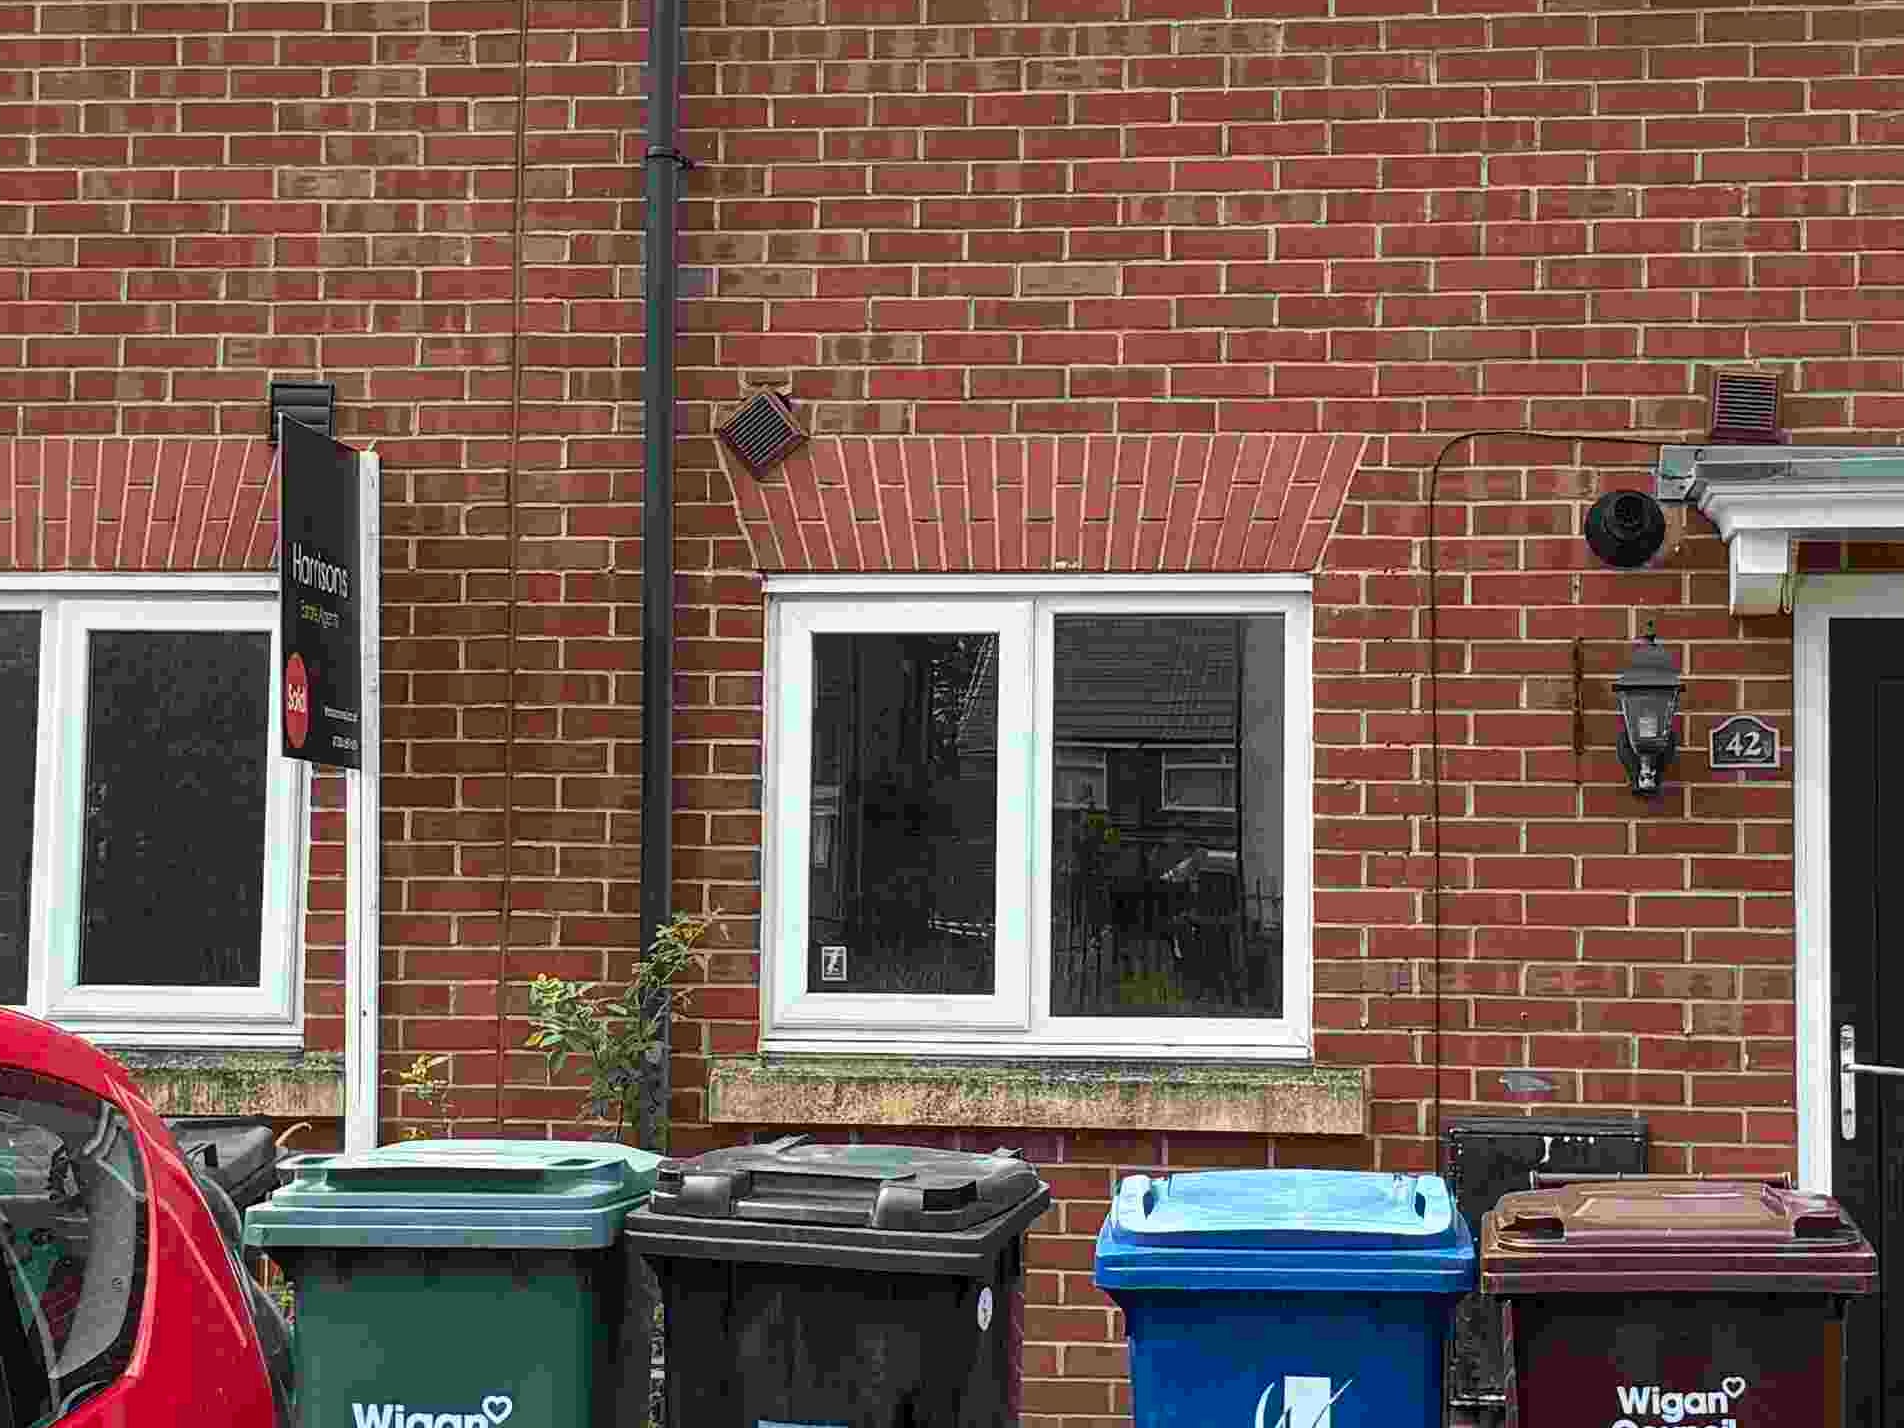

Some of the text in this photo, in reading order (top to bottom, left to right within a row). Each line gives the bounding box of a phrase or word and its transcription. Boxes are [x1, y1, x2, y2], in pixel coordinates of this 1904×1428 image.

[292, 541, 348, 599] Harrisons
[1726, 732, 1761, 757] 42
[1615, 1386, 1729, 1423] Wigan
